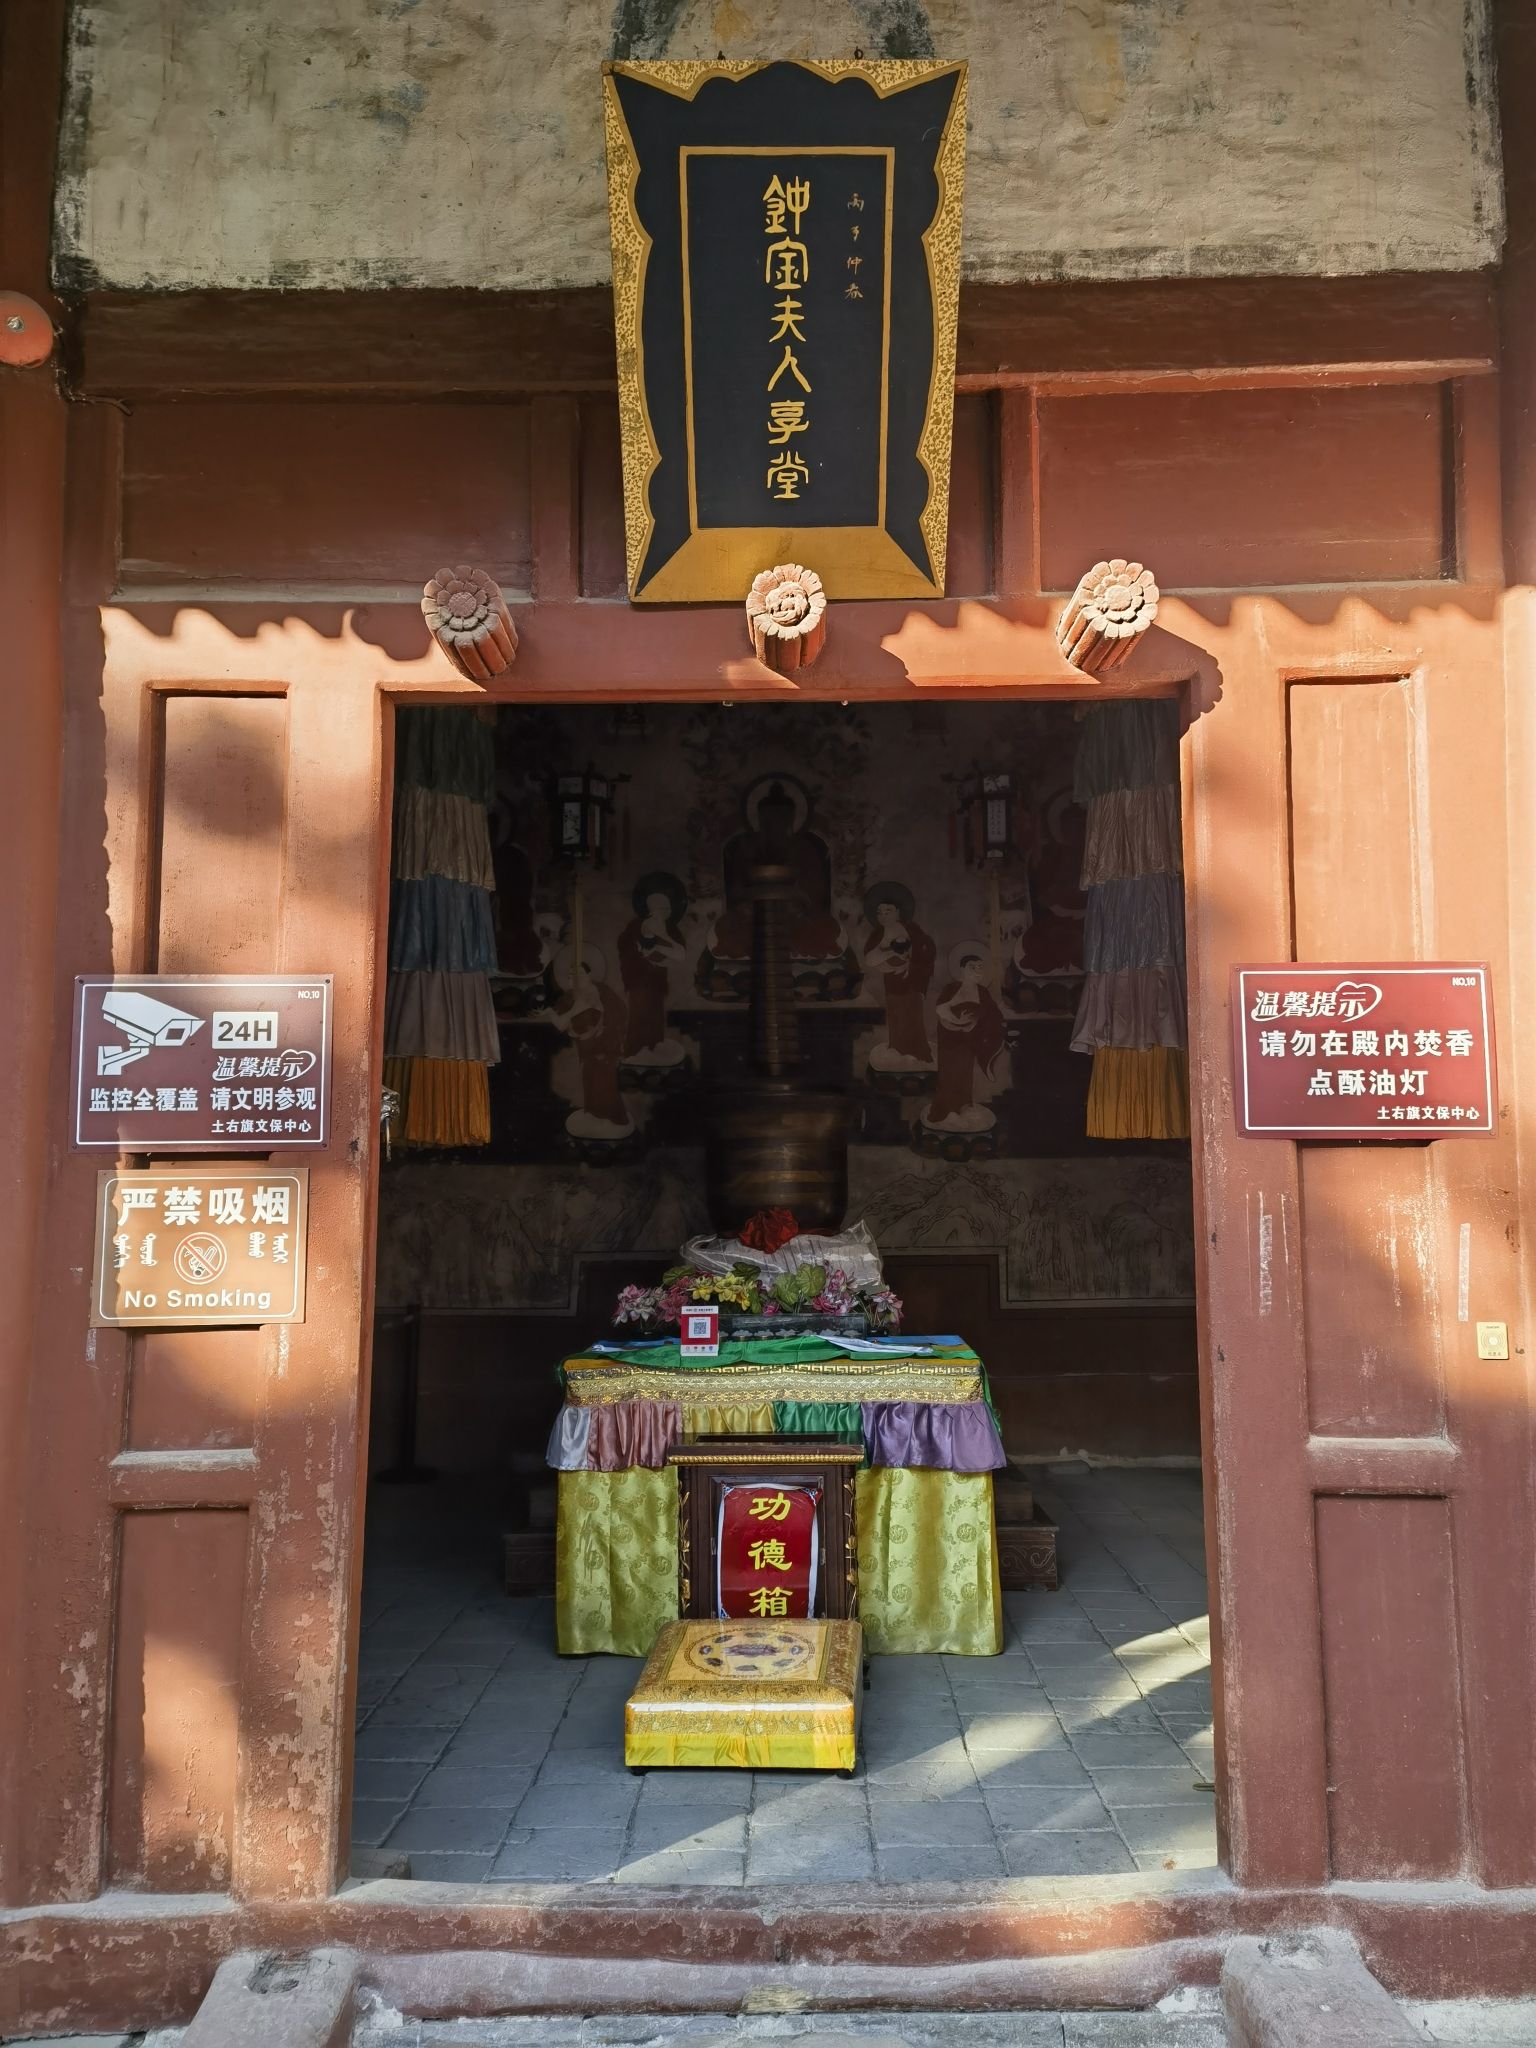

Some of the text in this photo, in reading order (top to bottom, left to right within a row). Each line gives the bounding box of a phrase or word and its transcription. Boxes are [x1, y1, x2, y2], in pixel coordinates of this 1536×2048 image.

[1252, 987, 1371, 1020] 温馨提示
[217, 1020, 272, 1042] 24H
[1258, 1029, 1474, 1057] 请勿在殿内焚香
[213, 1053, 308, 1080] 温馨提示
[1307, 1068, 1429, 1096] 点酥油灯
[88, 1087, 317, 1112] 监控全覆盖 请文明参观
[1377, 1106, 1480, 1120] 土右旗文保中心
[211, 1119, 312, 1133] 土右旗文保中心
[117, 1186, 290, 1226] 严禁吸烟
[124, 1288, 271, 1309] No Smoking
[748, 1492, 793, 1618] 功德箱
